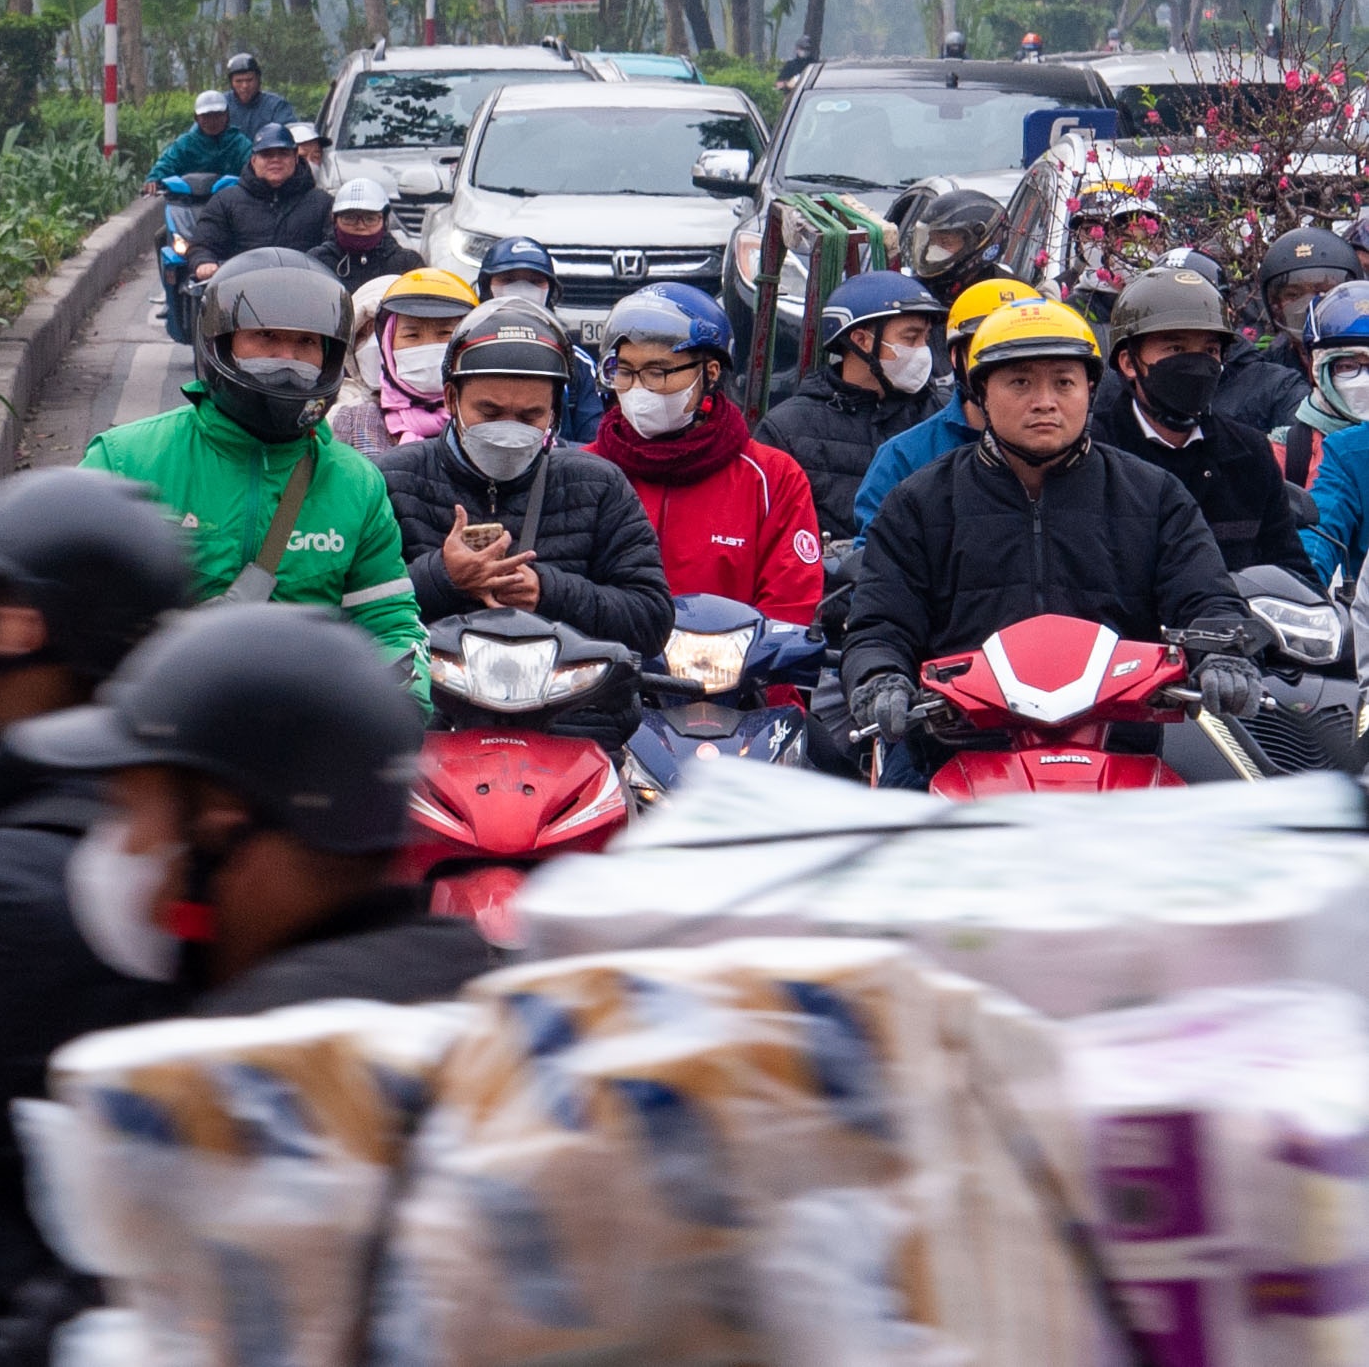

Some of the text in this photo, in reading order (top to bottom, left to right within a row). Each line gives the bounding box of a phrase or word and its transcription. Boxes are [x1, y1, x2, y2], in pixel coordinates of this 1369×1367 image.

[286, 528, 345, 552] Grab
[481, 737, 528, 746] HONDA
[1040, 755, 1092, 764] HONDA
